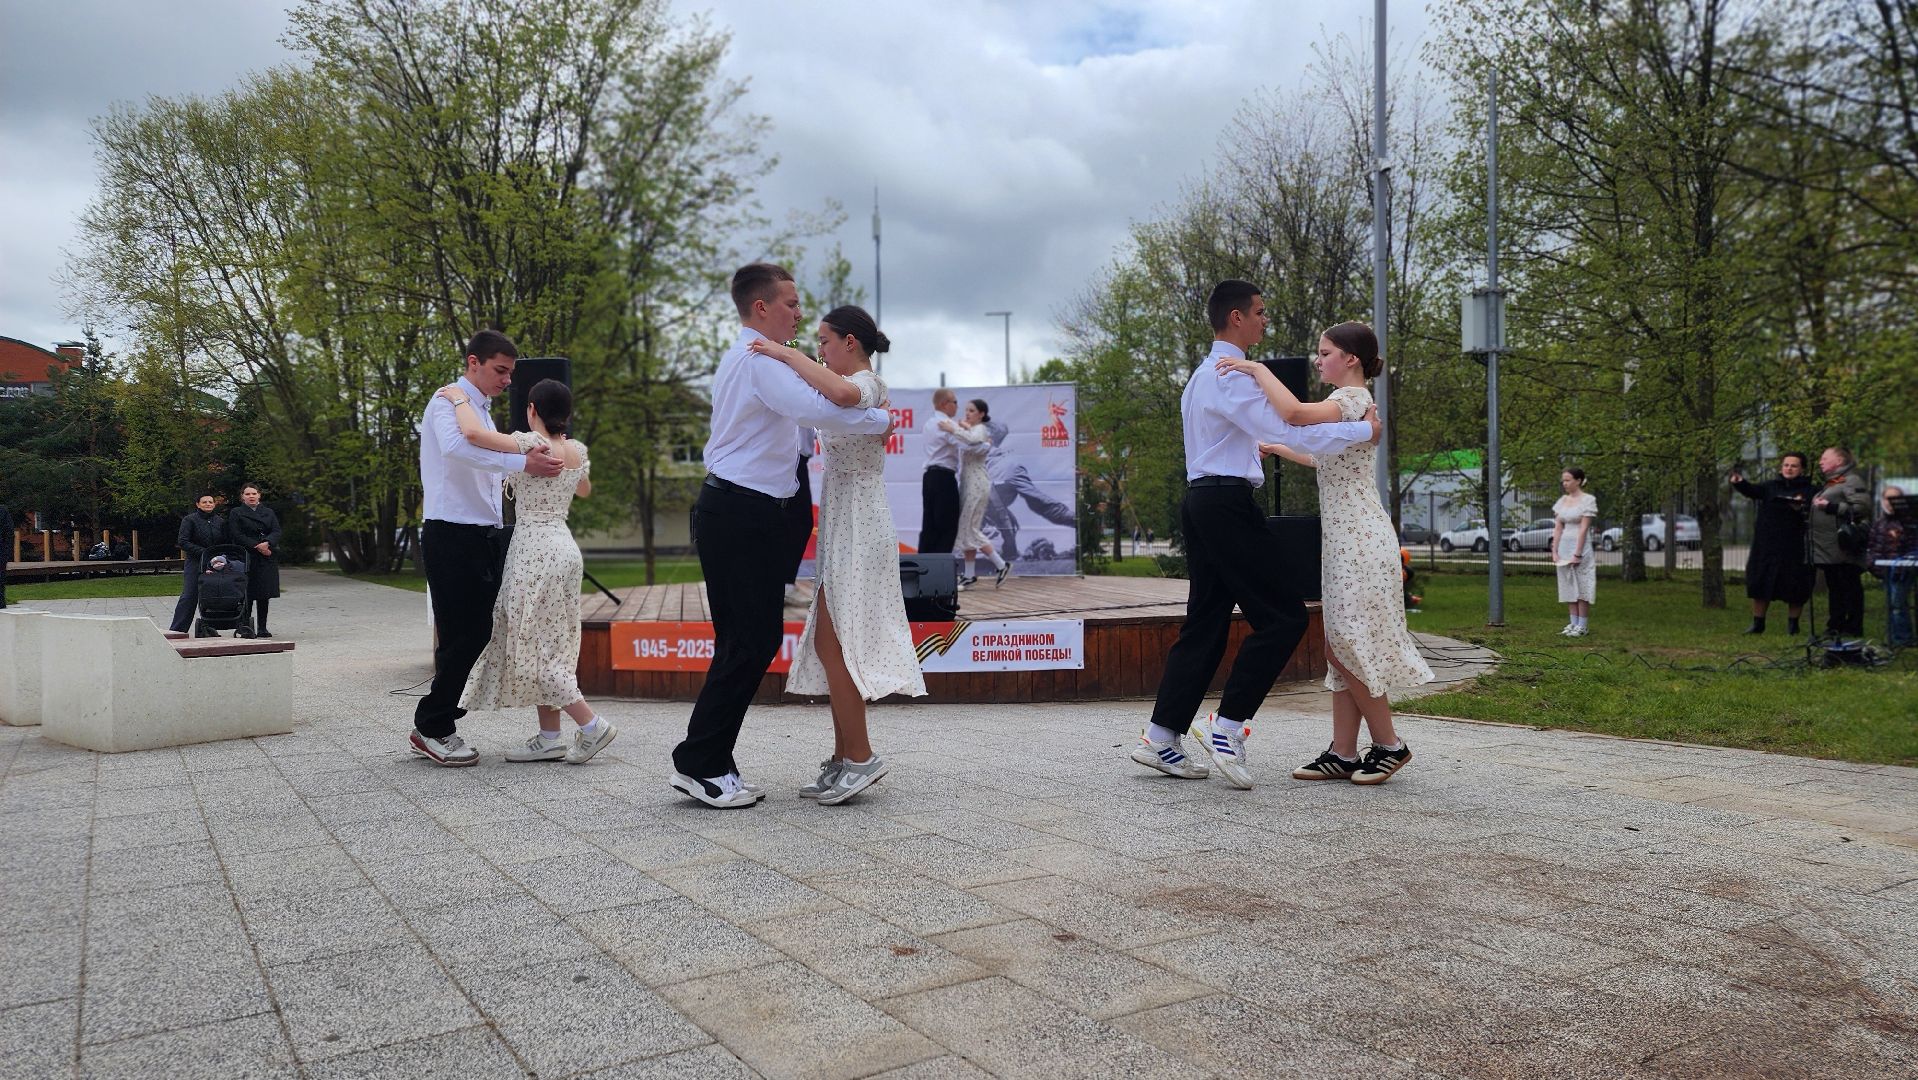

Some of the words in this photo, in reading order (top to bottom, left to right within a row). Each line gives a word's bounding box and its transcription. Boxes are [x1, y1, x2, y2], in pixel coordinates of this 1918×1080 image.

[972, 635, 980, 647] С
[982, 633, 1055, 647] ПРАЗДНИКОМ
[972, 648, 1022, 662] ВЕЛИКОЙ
[1025, 648, 1072, 661] ПОБЕДЫ!
